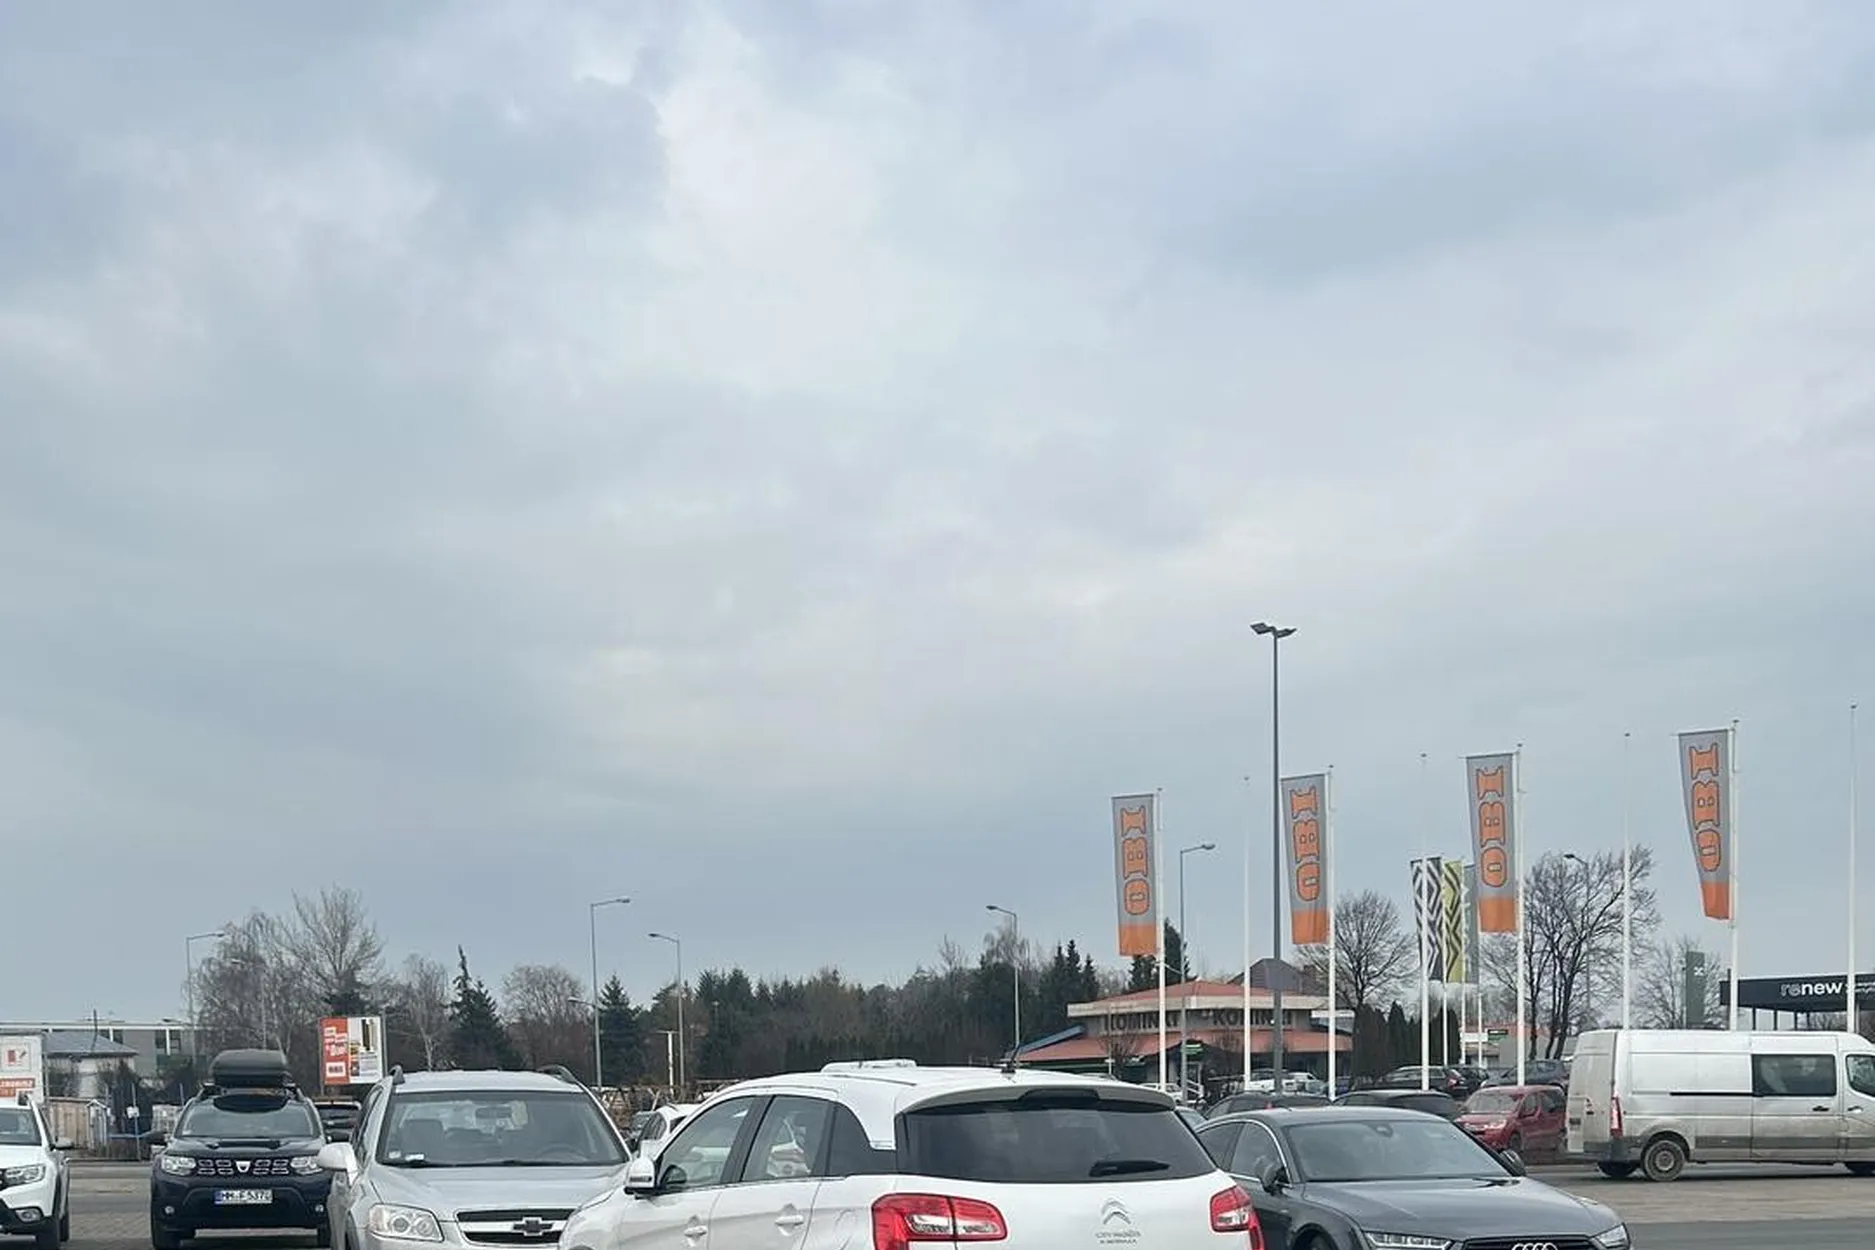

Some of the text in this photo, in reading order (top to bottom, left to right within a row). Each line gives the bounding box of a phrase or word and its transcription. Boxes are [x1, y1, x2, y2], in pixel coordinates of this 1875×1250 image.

[1120, 805, 1150, 916] OBI
[1290, 785, 1321, 901] OBI
[1475, 765, 1508, 888] OBI
[1689, 742, 1722, 872] OBI
[1780, 982, 1843, 997] renew
